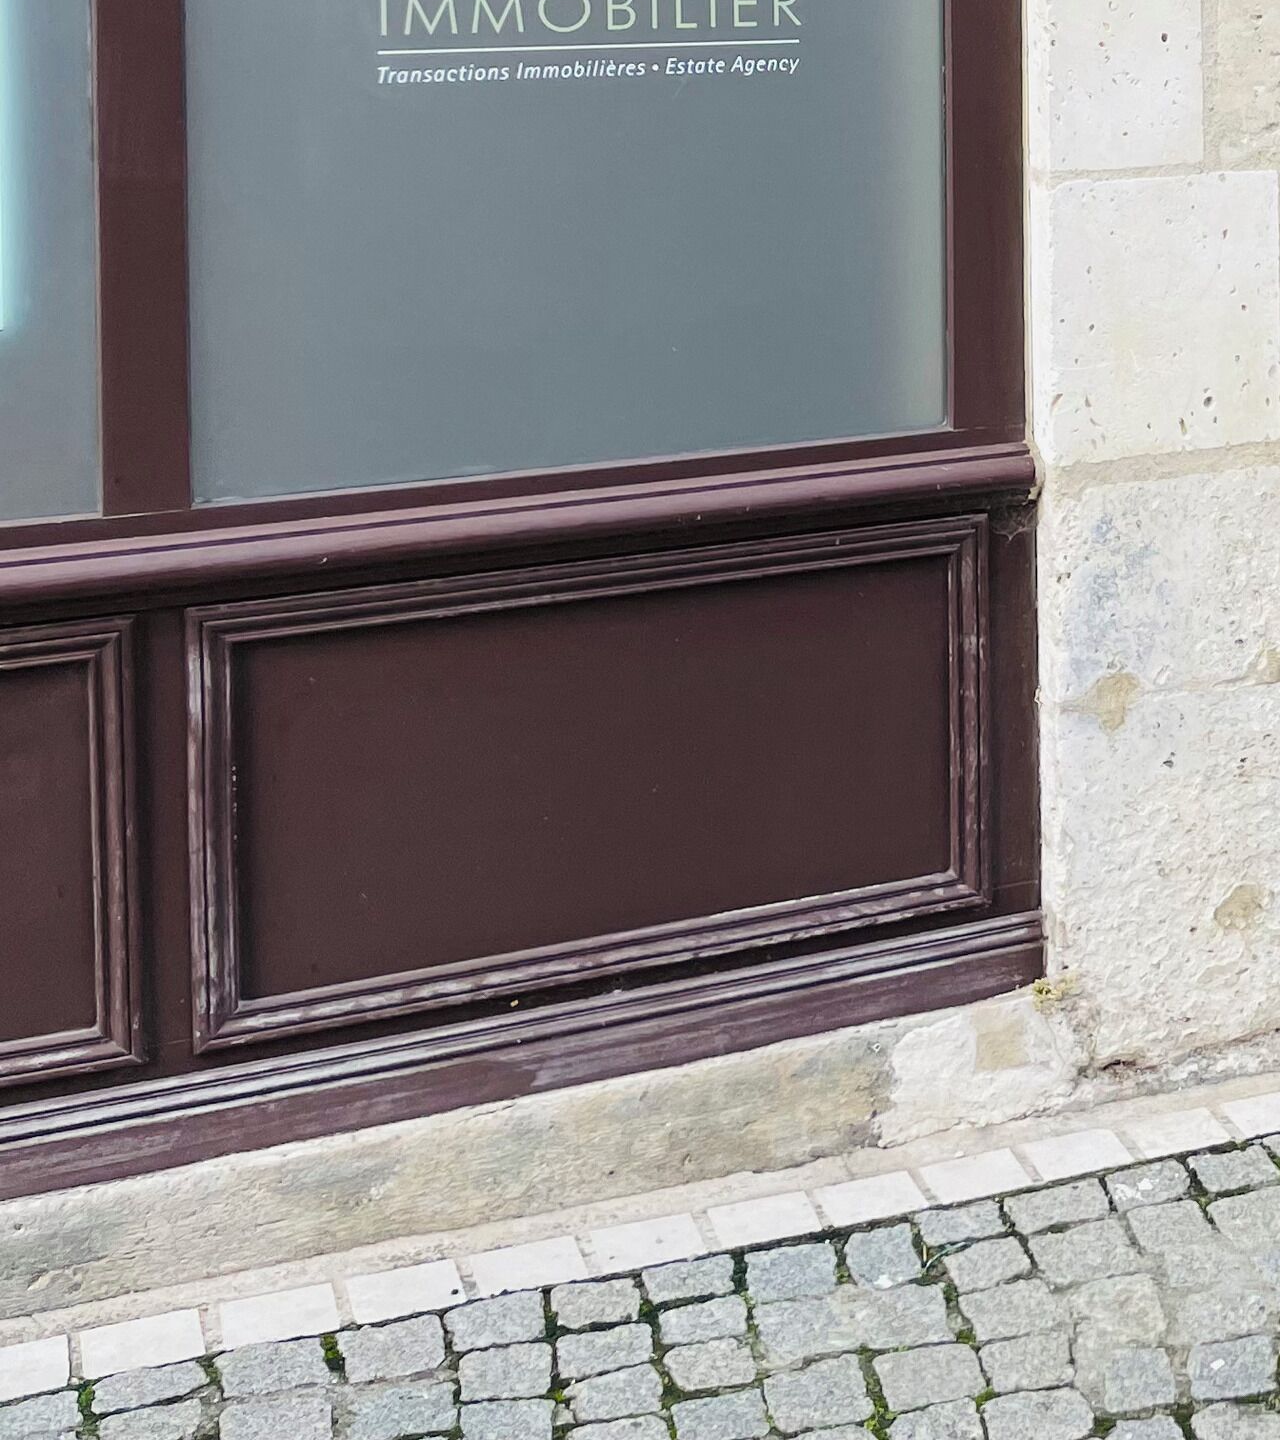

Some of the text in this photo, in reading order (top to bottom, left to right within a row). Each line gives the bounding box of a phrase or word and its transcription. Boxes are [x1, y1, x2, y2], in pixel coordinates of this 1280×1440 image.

[376, 54, 800, 85] Transactions Immobilières Estate Agency
